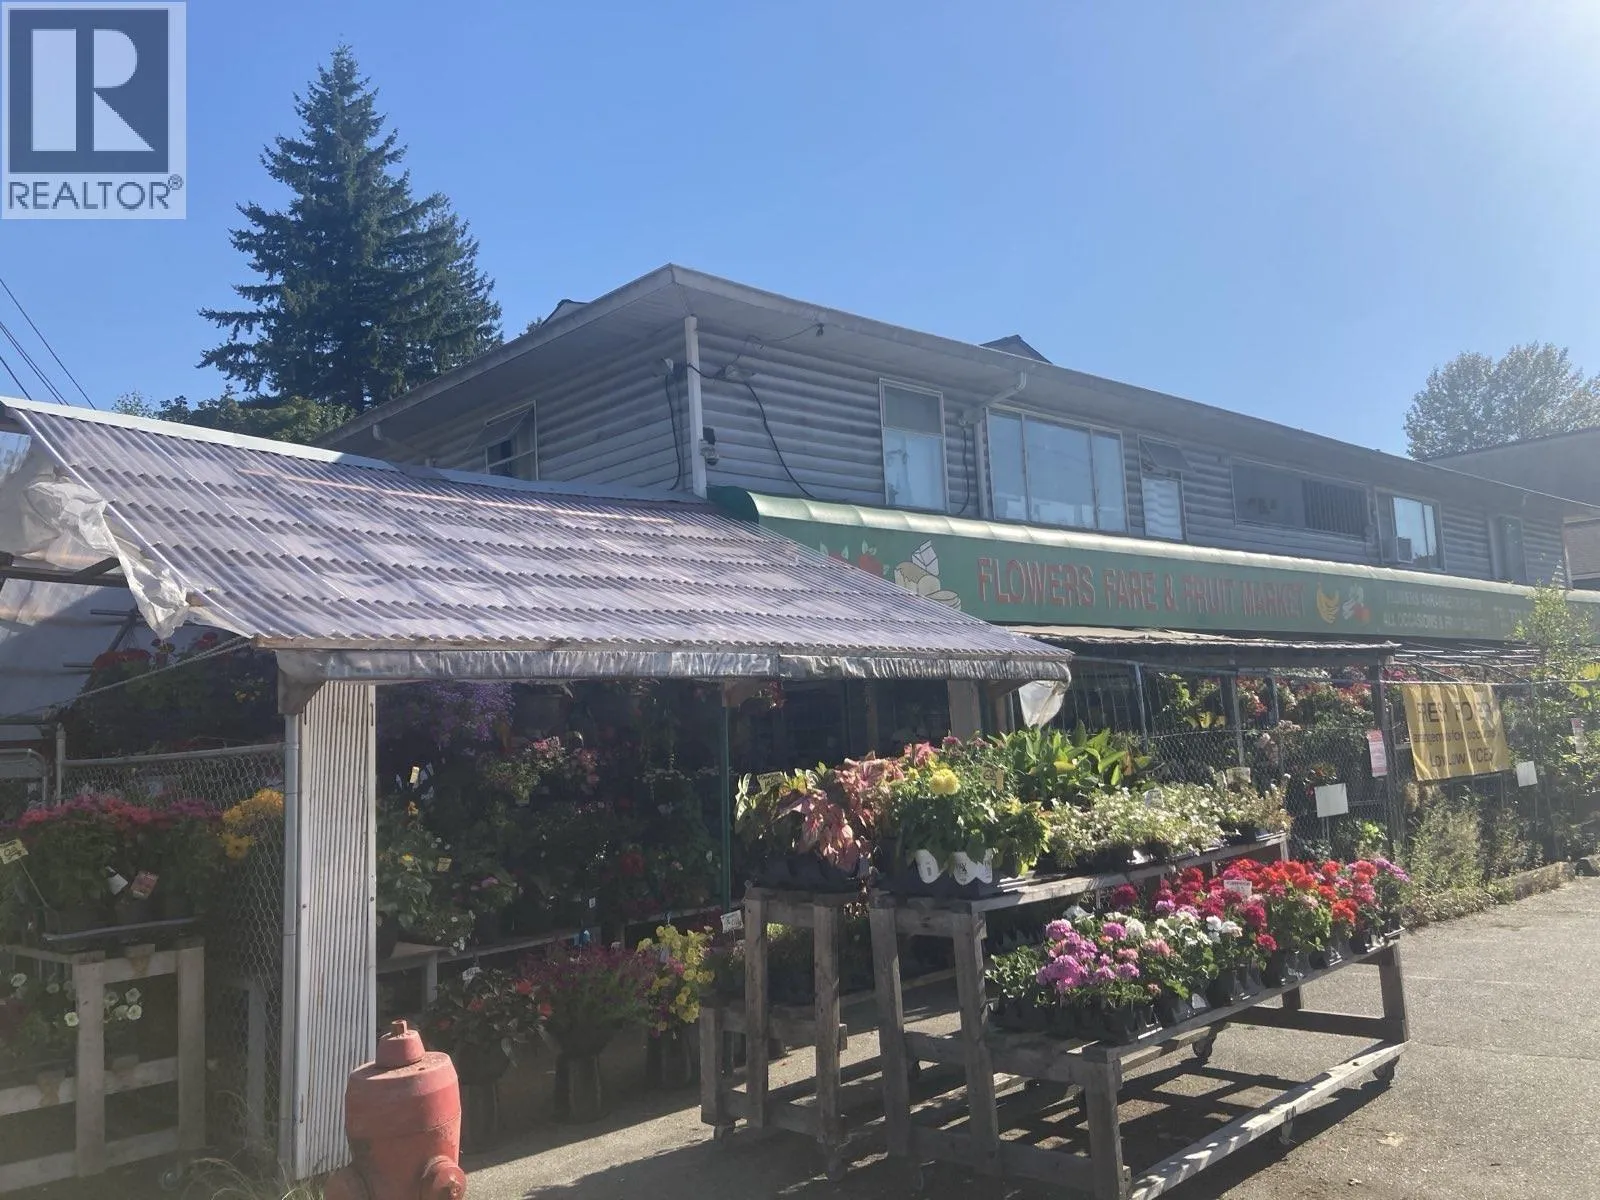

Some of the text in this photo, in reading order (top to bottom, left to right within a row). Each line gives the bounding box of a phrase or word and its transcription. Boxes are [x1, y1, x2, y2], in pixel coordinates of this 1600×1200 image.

[977, 556, 1307, 618] FLOWERS FARE & FRUIT MARKET
